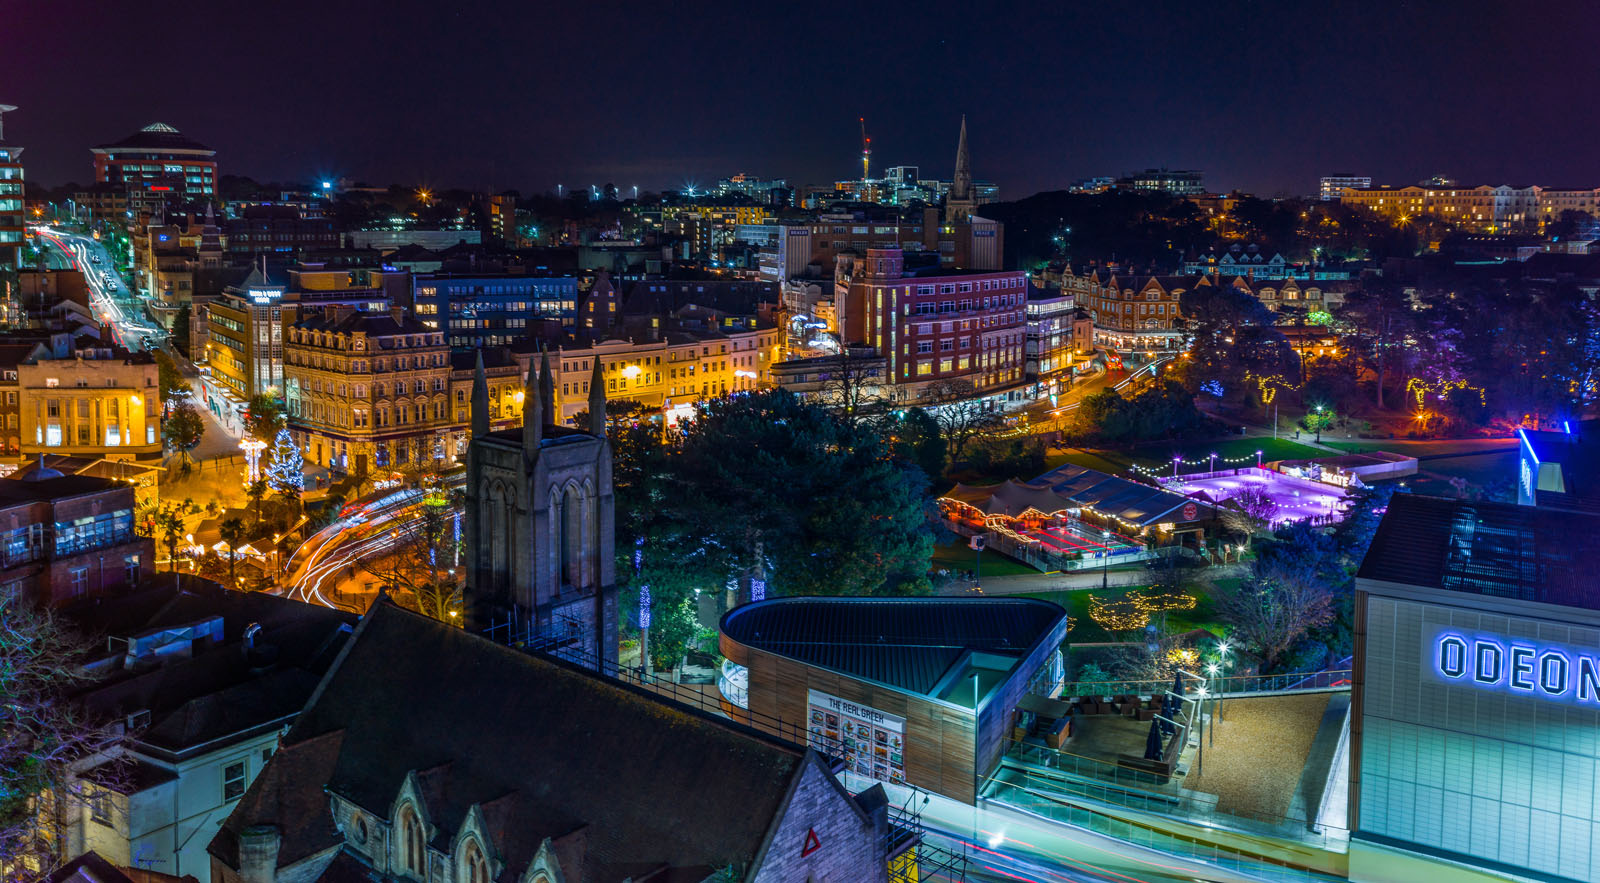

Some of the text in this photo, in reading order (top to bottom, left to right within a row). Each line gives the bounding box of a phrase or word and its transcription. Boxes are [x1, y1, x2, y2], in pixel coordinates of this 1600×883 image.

[1320, 471, 1350, 487] SKATE
[1439, 635, 1600, 703] ODEON
[829, 698, 884, 724] THE REAL GREEK
